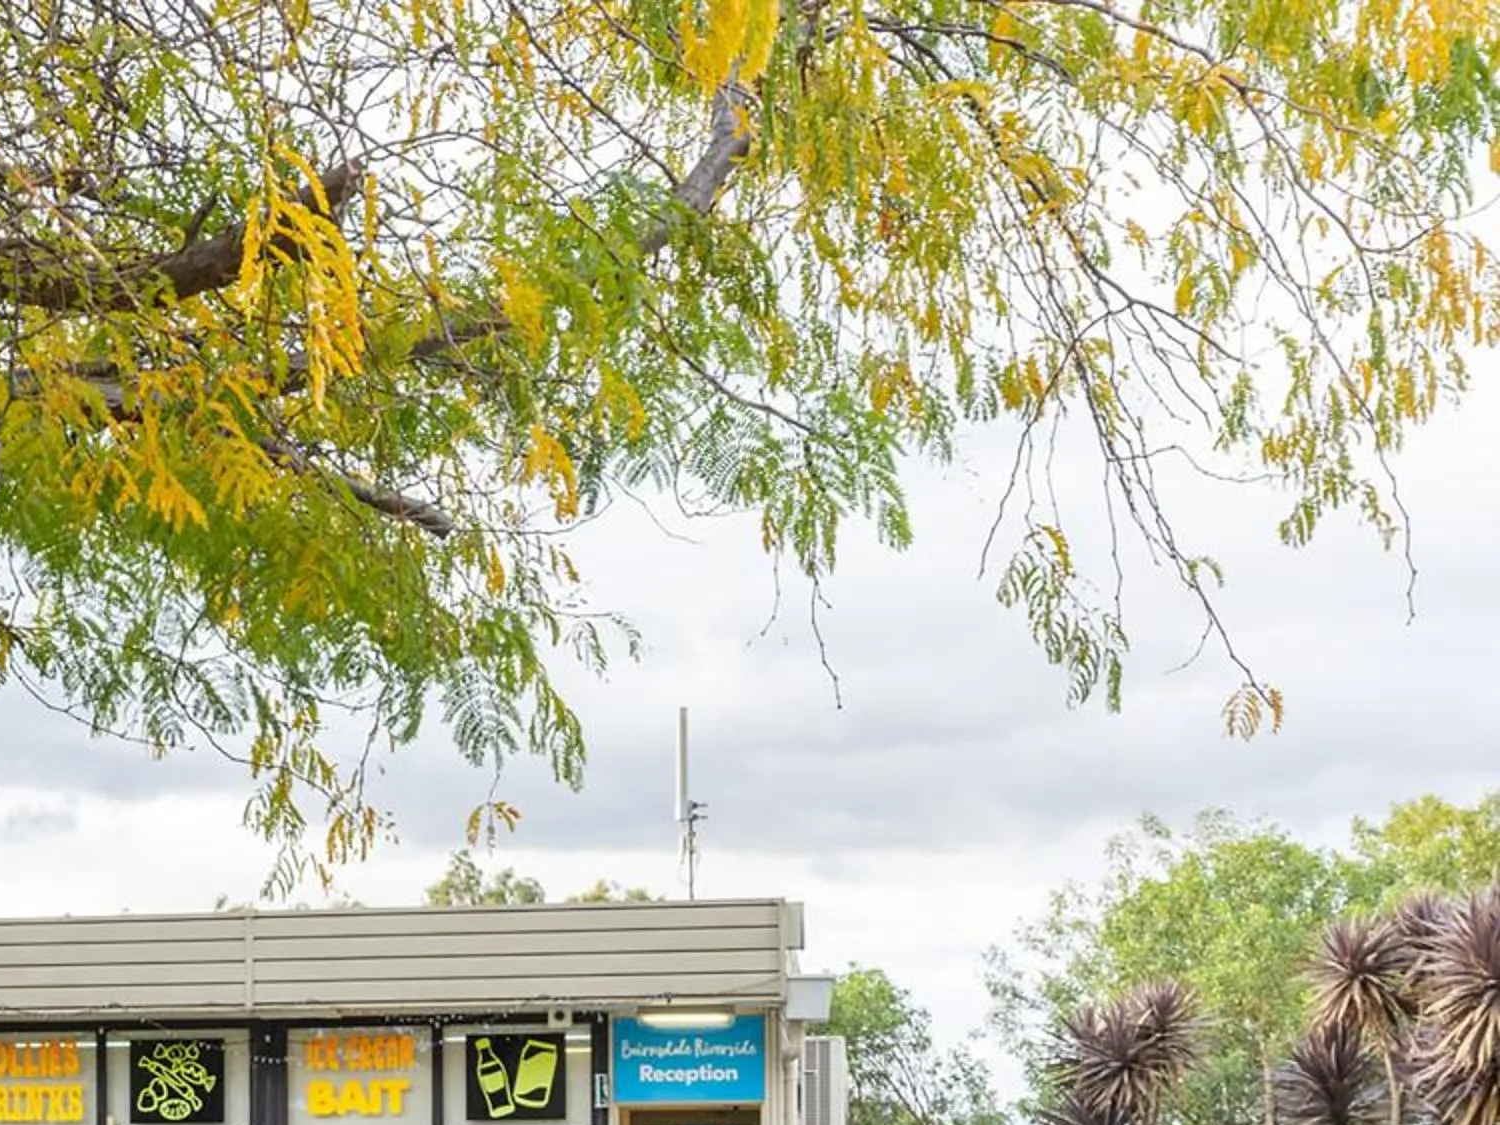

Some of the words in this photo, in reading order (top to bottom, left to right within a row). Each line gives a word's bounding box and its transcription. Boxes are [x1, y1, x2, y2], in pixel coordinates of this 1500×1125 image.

[621, 1039, 691, 1059] Bairnsdale
[694, 1037, 757, 1058] Riverside
[639, 1064, 738, 1087] Reception
[308, 1079, 410, 1116] BAIT
